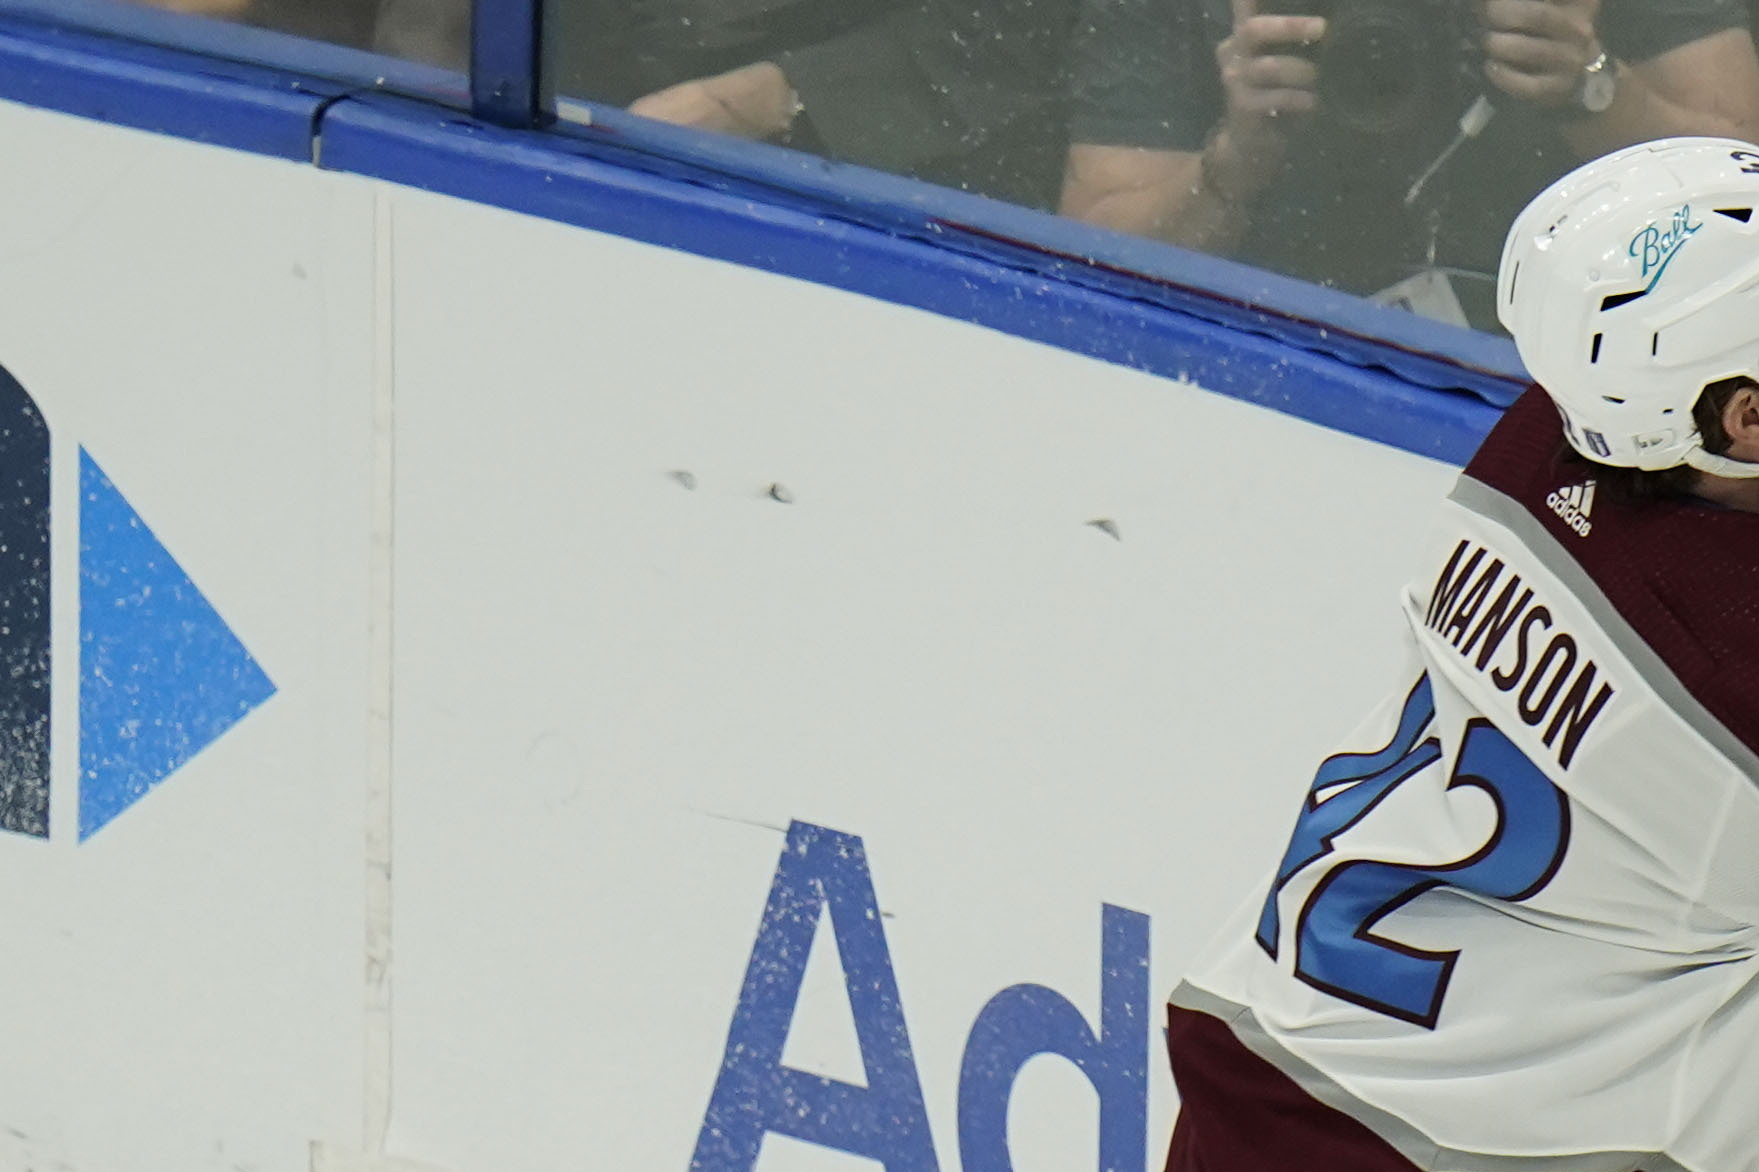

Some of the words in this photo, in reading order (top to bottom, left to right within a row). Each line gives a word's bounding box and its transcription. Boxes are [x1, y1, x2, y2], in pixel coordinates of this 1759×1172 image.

[1629, 203, 1703, 290] Ball
[1546, 491, 1593, 537] adidas
[1424, 538, 1615, 771] MANSON
